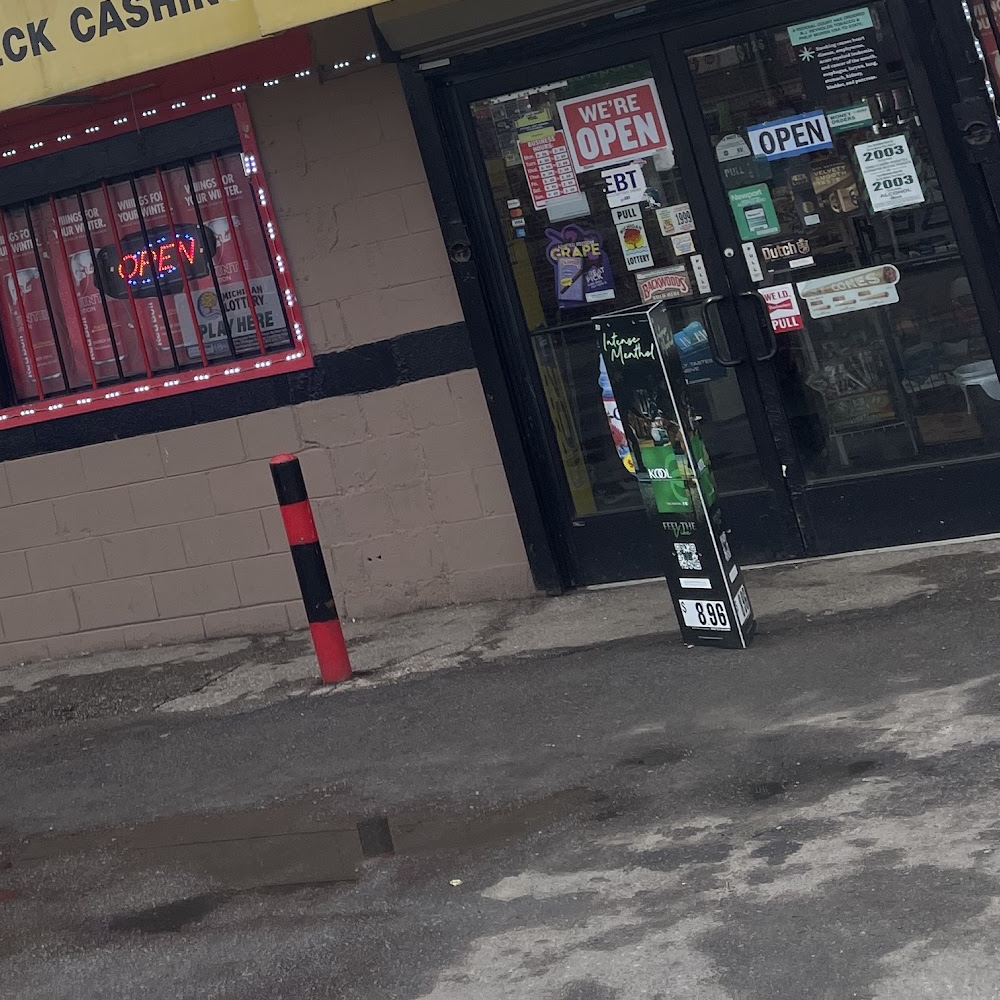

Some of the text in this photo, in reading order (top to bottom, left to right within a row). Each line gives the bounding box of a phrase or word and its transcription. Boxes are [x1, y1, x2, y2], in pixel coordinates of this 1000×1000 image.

[577, 93, 641, 124] WE'RE
[831, 115, 855, 124] ORDERS
[576, 111, 661, 161] OPEN
[759, 118, 826, 155] OPEN
[863, 145, 905, 162] 2003
[724, 167, 745, 178] PULL
[815, 170, 846, 181] SMOOTH
[604, 170, 638, 194] EBT
[872, 174, 914, 192] 2003
[730, 189, 763, 201] Newport
[881, 188, 911, 198] ALCOHOL
[617, 208, 637, 220] PULL
[675, 210, 692, 226] 1999
[118, 237, 195, 280] OPEN
[550, 242, 601, 261] GRAPE
[761, 242, 798, 260] Dutch
[627, 254, 650, 266] LOTTERY
[642, 275, 689, 301] BACKWOODS
[831, 272, 881, 292] CONES
[222, 284, 264, 301] MICHIAN
[764, 291, 777, 301] WE
[772, 317, 800, 331] PULL
[602, 331, 641, 352] Intense
[611, 342, 656, 366] Menthol
[648, 468, 673, 479] KOOL
[680, 522, 697, 531] THE
